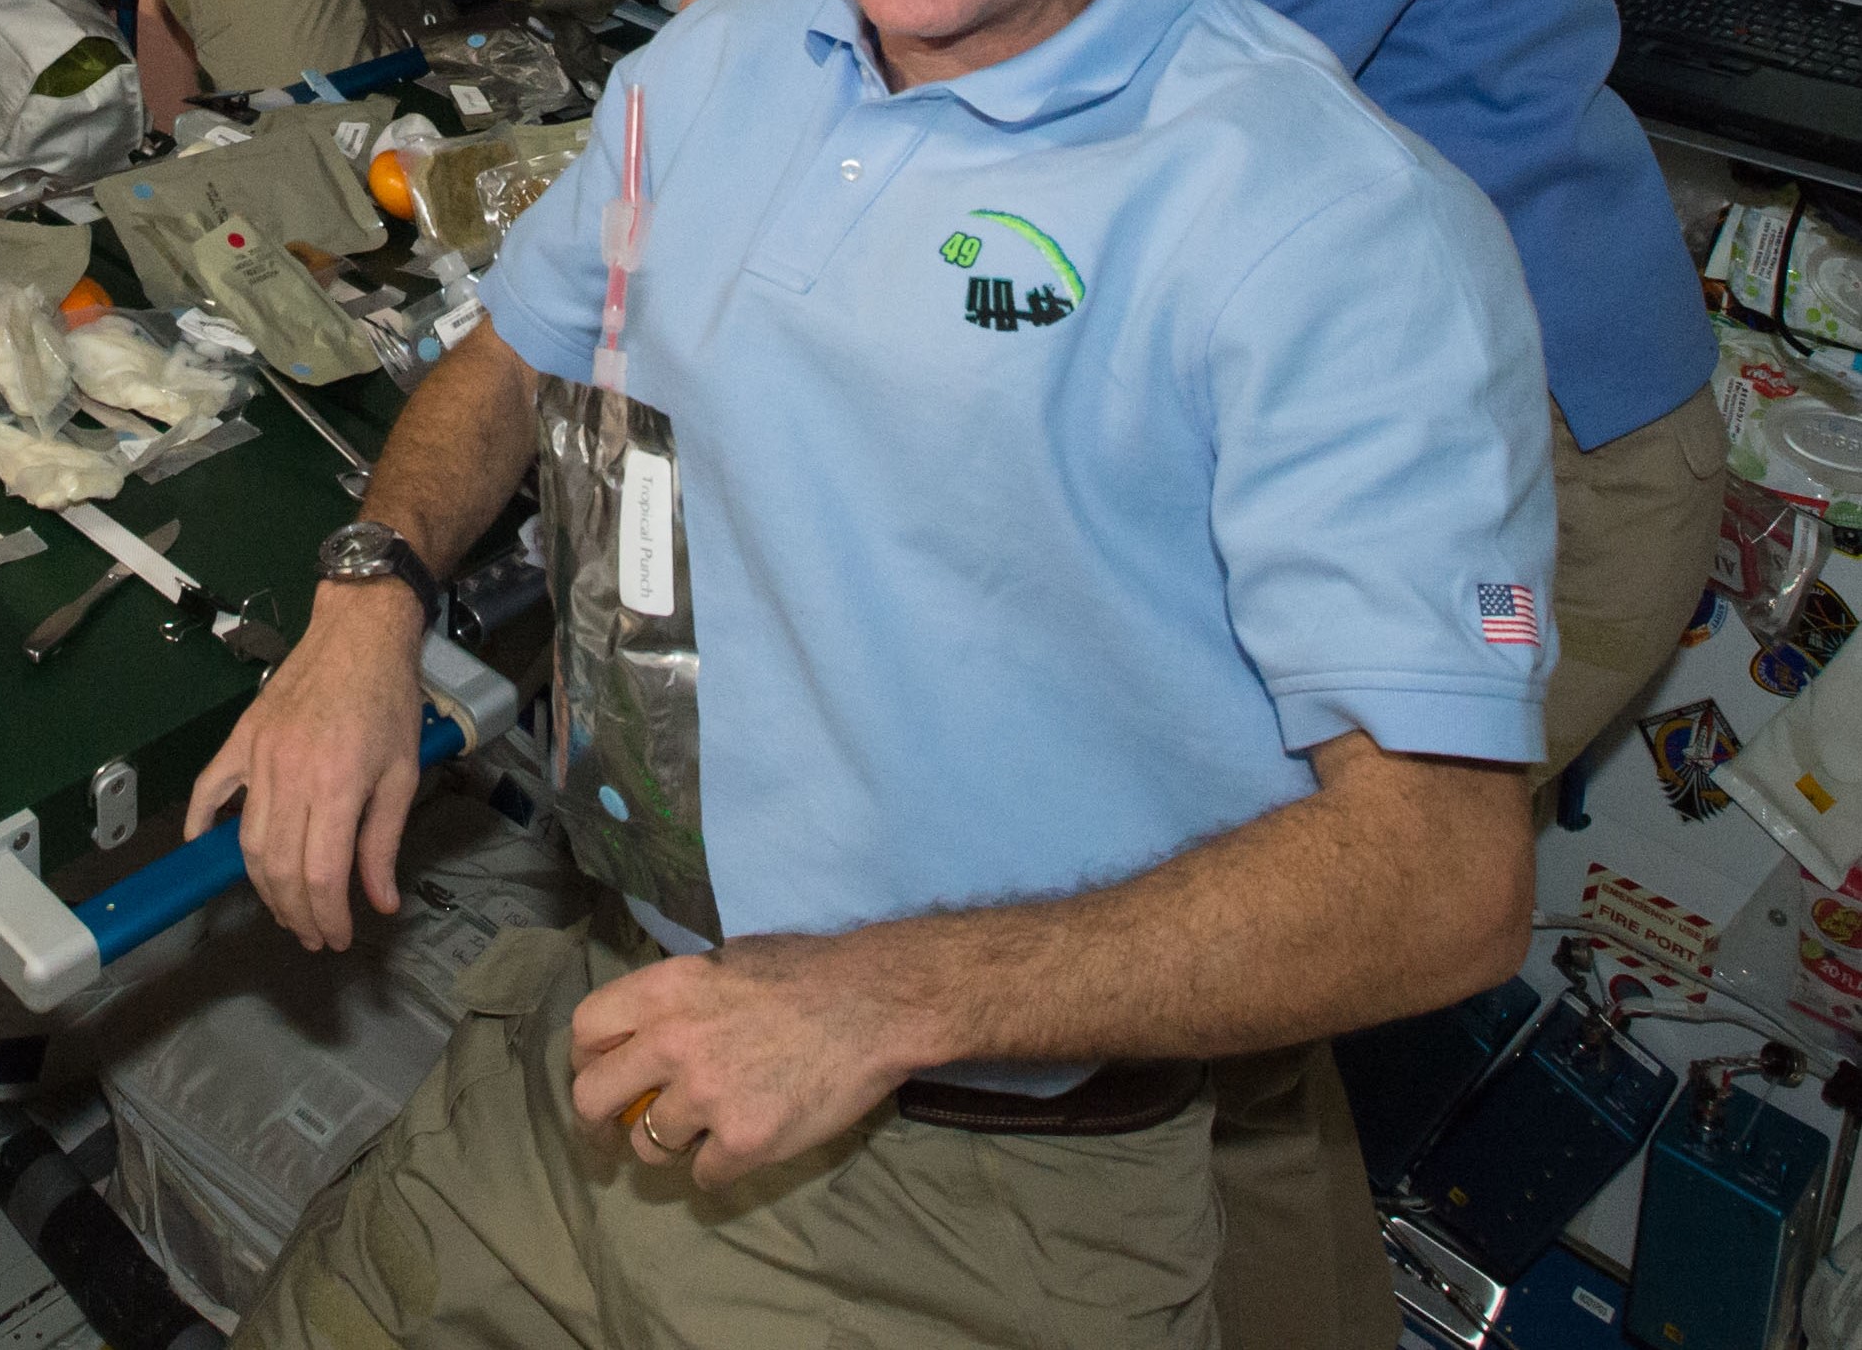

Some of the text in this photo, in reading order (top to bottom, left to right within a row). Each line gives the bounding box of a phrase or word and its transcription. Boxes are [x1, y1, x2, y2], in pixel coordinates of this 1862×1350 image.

[940, 231, 982, 268] 49
[637, 476, 654, 599] Tropical Punch
[1599, 905, 1641, 935] FIRE
[1645, 928, 1698, 963] PORT
[1602, 883, 1703, 942] EMERGENCY USE
